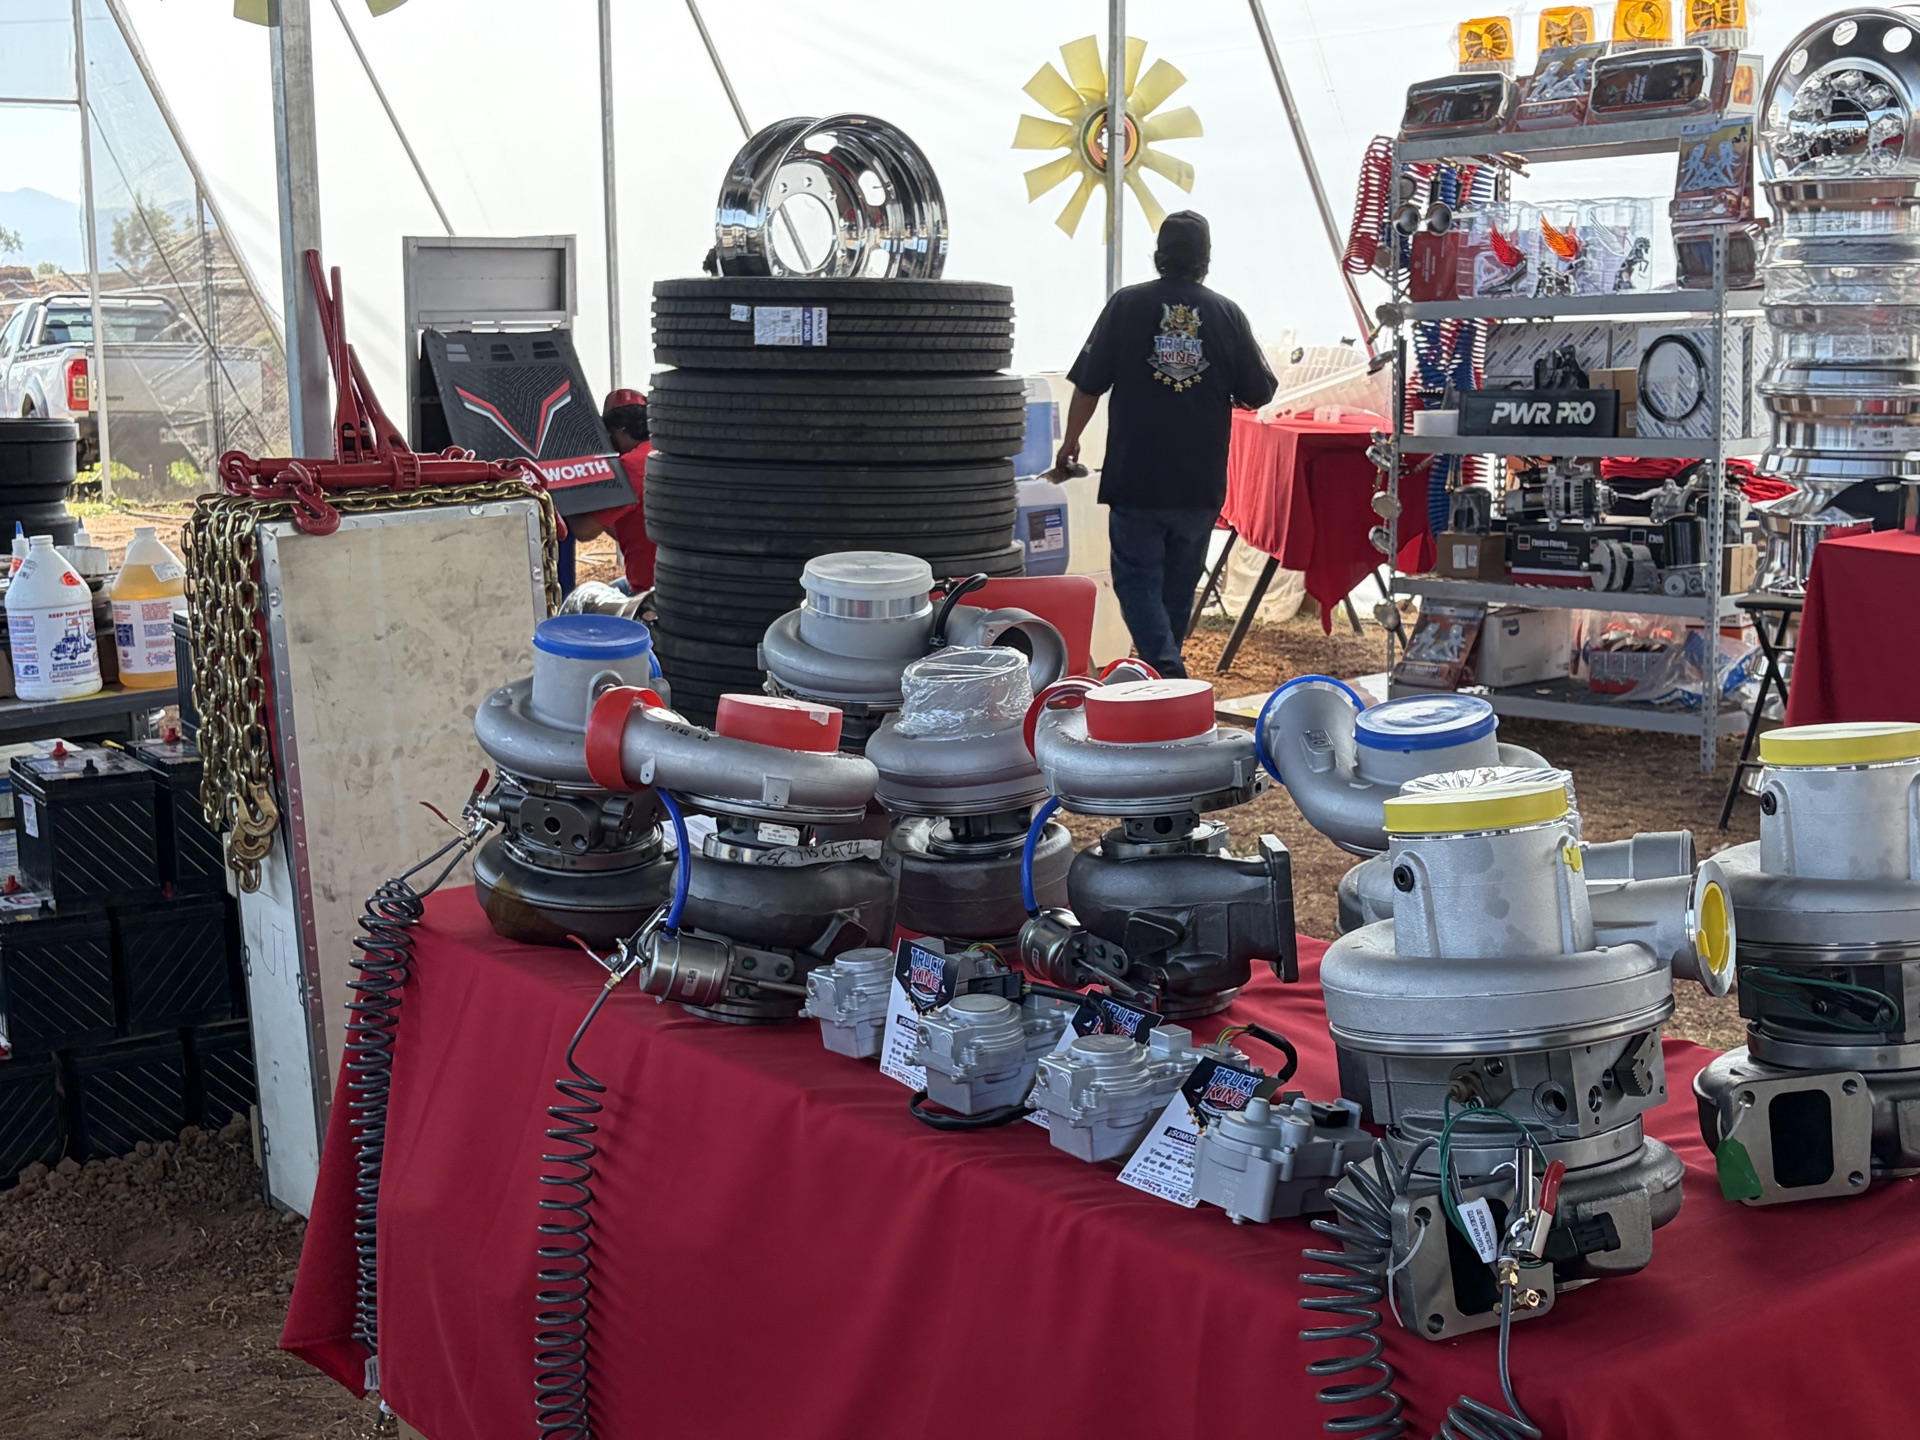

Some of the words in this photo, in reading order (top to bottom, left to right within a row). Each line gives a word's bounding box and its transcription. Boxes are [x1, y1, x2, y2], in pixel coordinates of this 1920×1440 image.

[1154, 335, 1203, 356] TRUCK
[1158, 350, 1200, 367] KING
[1491, 401, 1552, 425] PWR
[1555, 400, 1596, 425] PRO
[910, 946, 946, 980] TRUCK
[910, 966, 941, 994] KING
[1101, 999, 1146, 1033] TRUCK
[1209, 1065, 1263, 1097] TRUCK
[1201, 1083, 1247, 1110] KING
